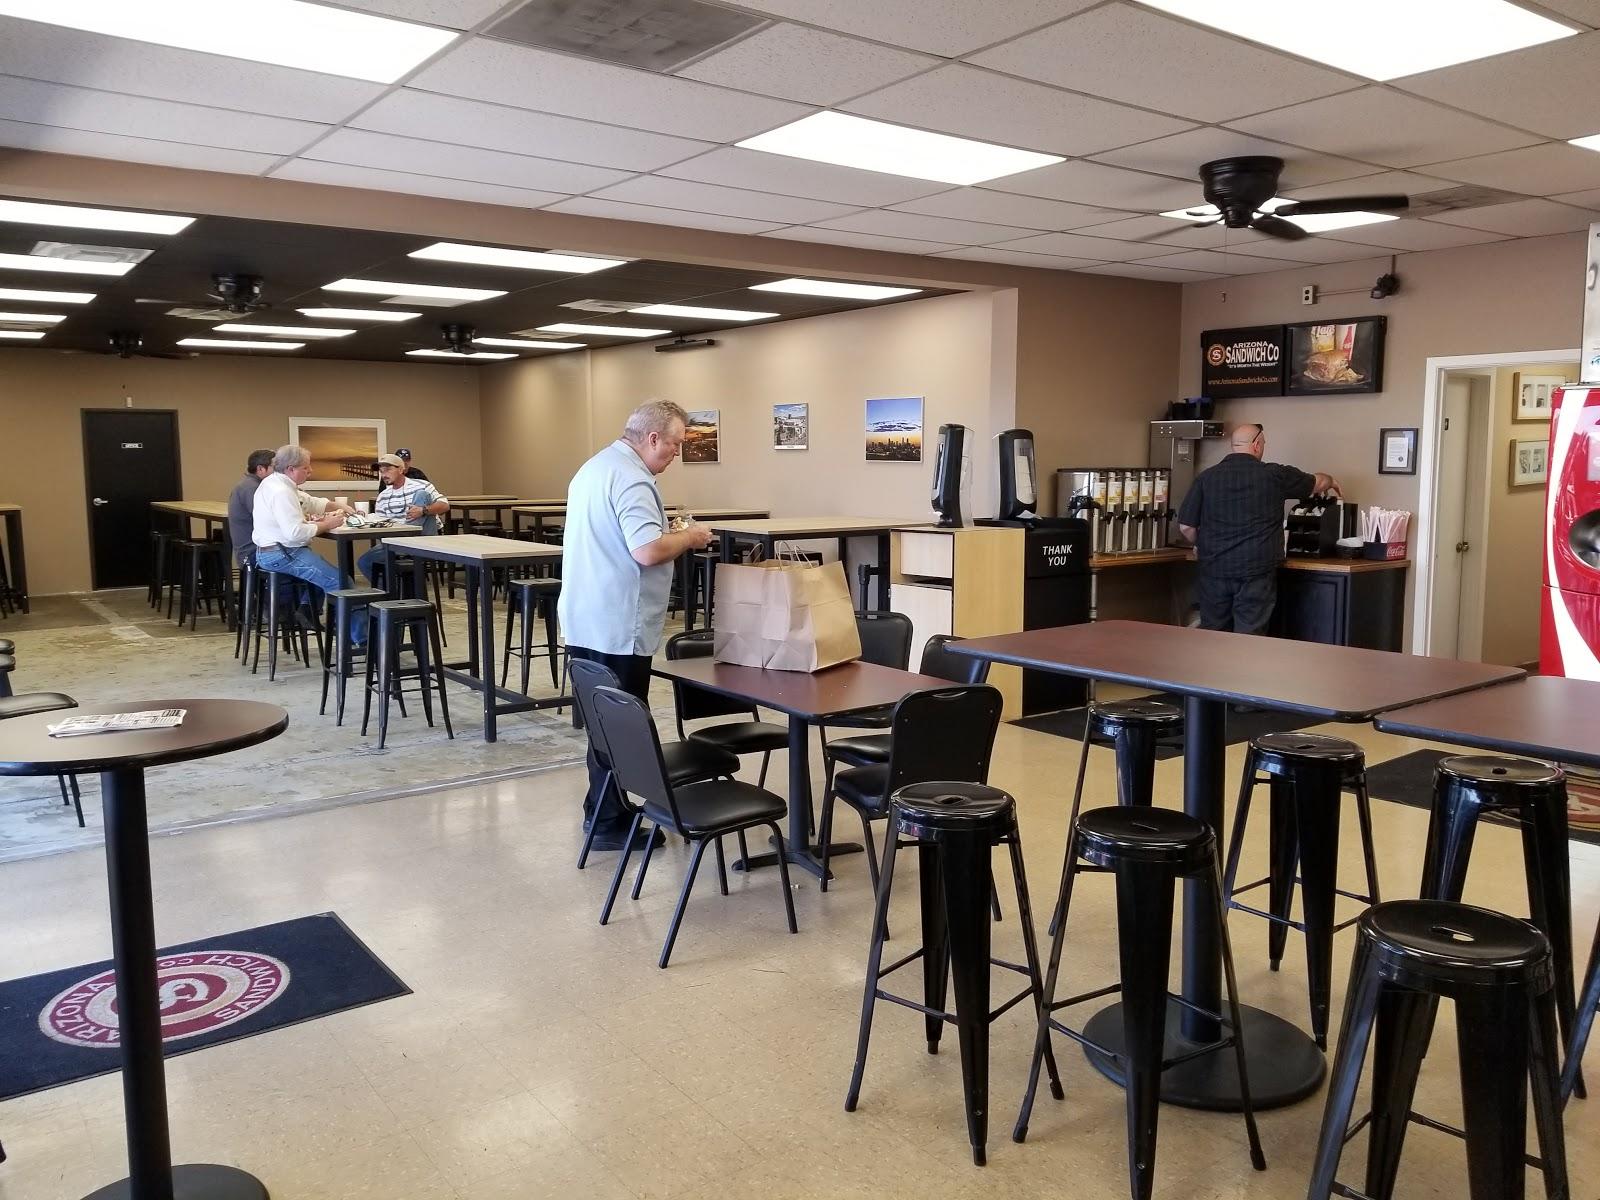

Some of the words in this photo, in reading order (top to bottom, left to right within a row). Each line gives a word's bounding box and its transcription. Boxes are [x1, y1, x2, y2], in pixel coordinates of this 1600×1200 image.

[1233, 340, 1269, 349] ARIZONA
[1225, 346, 1267, 364] SANDWICH
[1042, 544, 1073, 555] THANK
[1048, 556, 1067, 566] YOU
[203, 955, 276, 1020] SANDWICH
[55, 982, 121, 1041] ARIZONA
